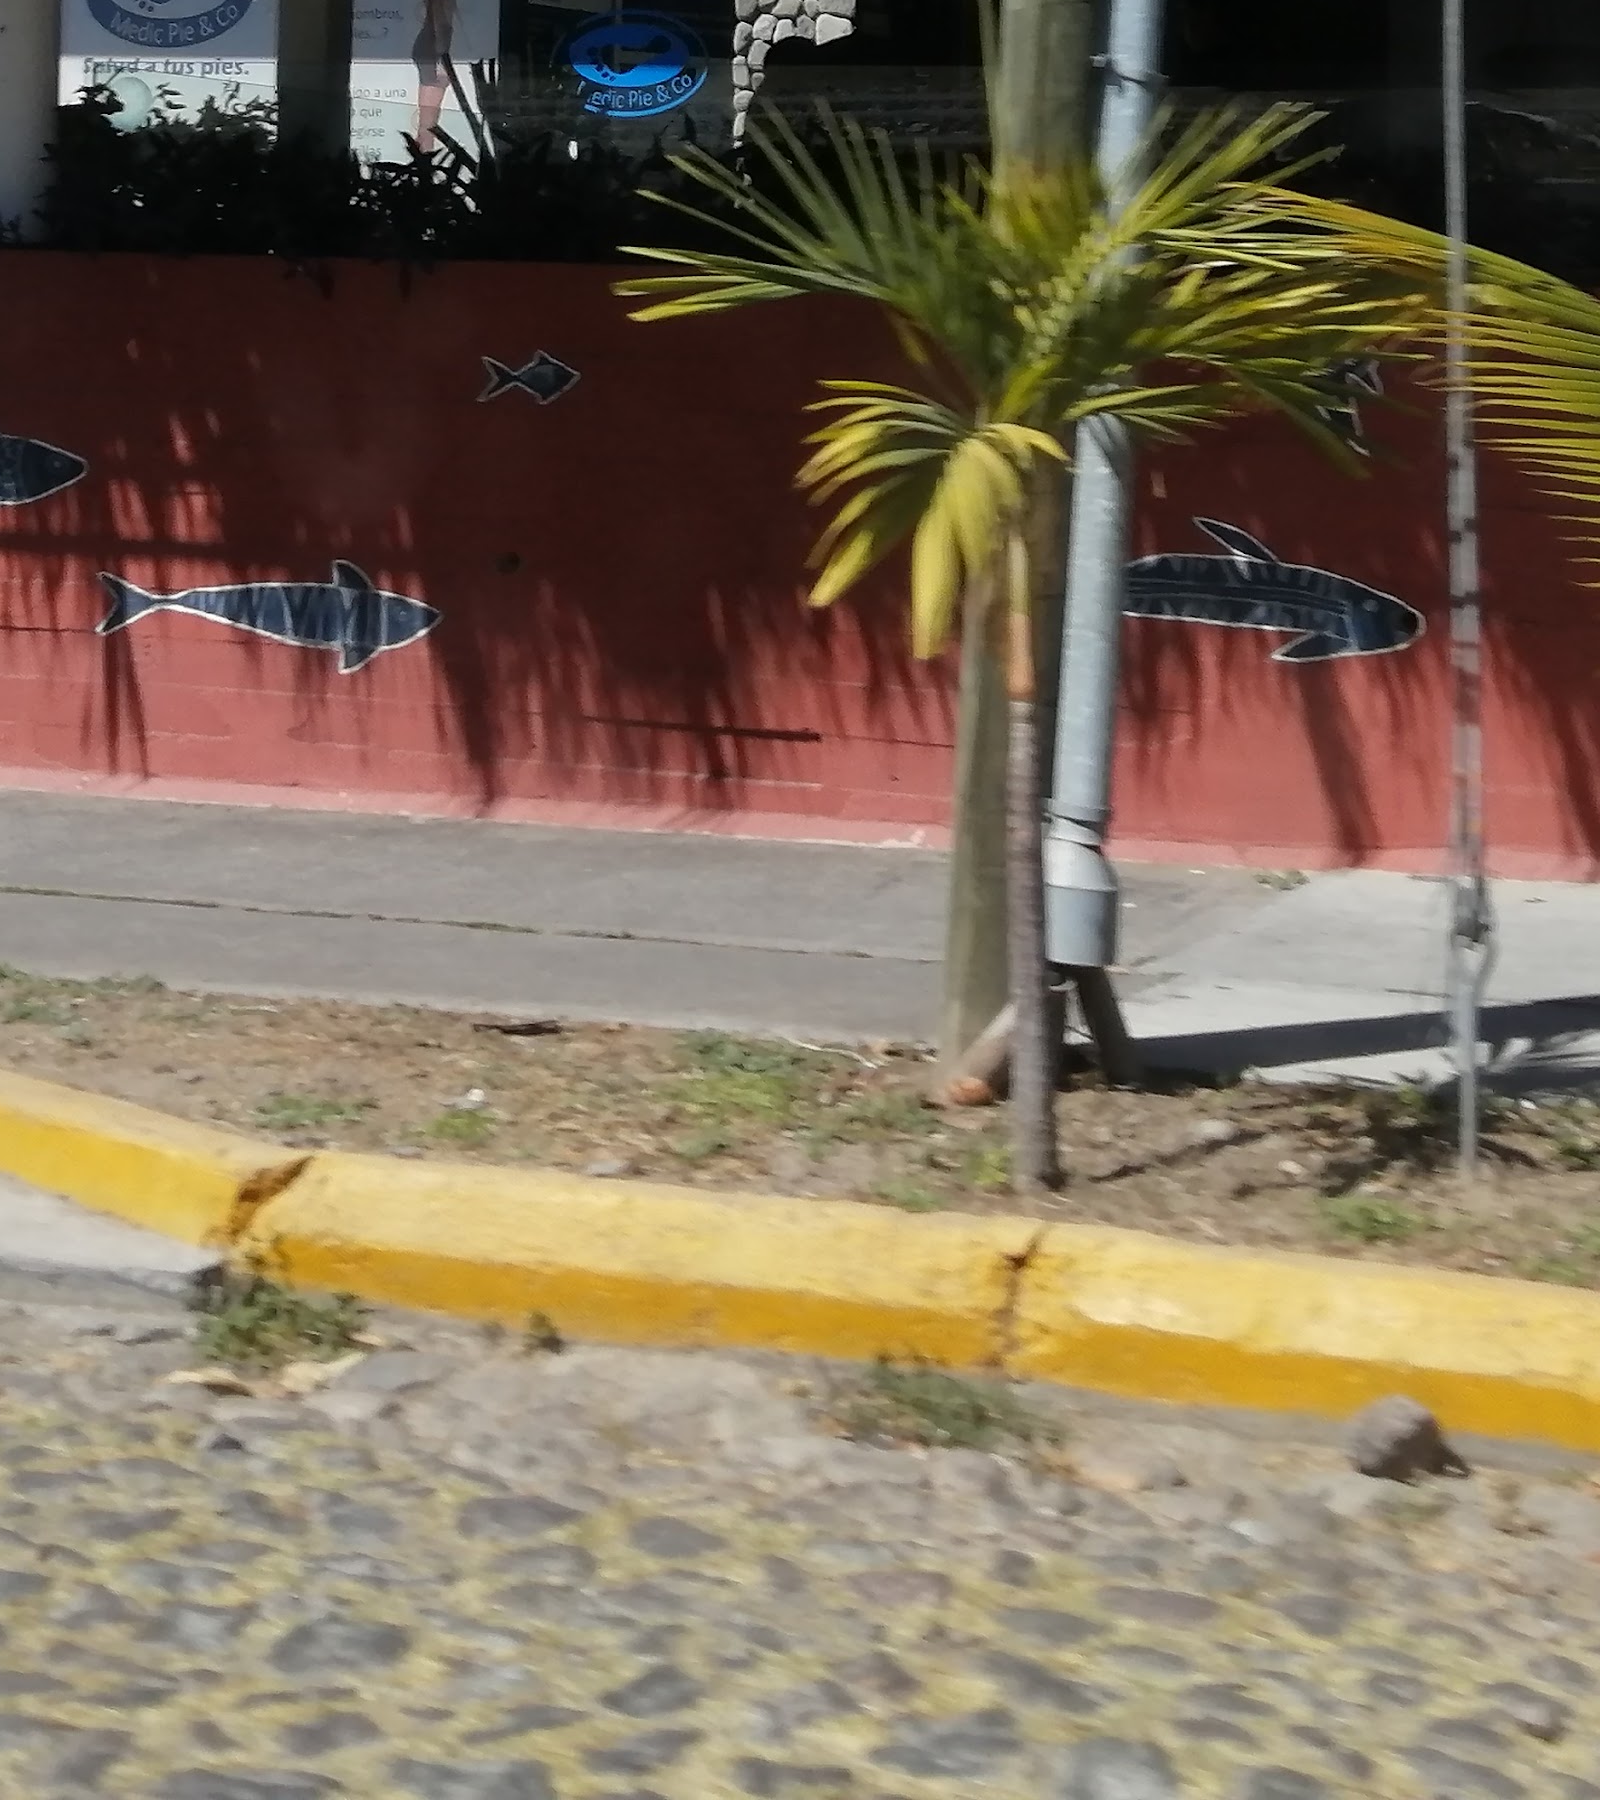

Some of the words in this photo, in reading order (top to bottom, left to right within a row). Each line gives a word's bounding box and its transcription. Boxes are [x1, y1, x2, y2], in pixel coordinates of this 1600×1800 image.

[110, 11, 164, 45] Medic
[168, 22, 196, 44] Pie
[198, 16, 215, 36] &
[215, 4, 239, 27] Co
[161, 58, 194, 75] tus
[384, 88, 408, 98] una
[628, 89, 654, 109] Pie
[655, 84, 672, 103] &
[671, 73, 693, 95] Co
